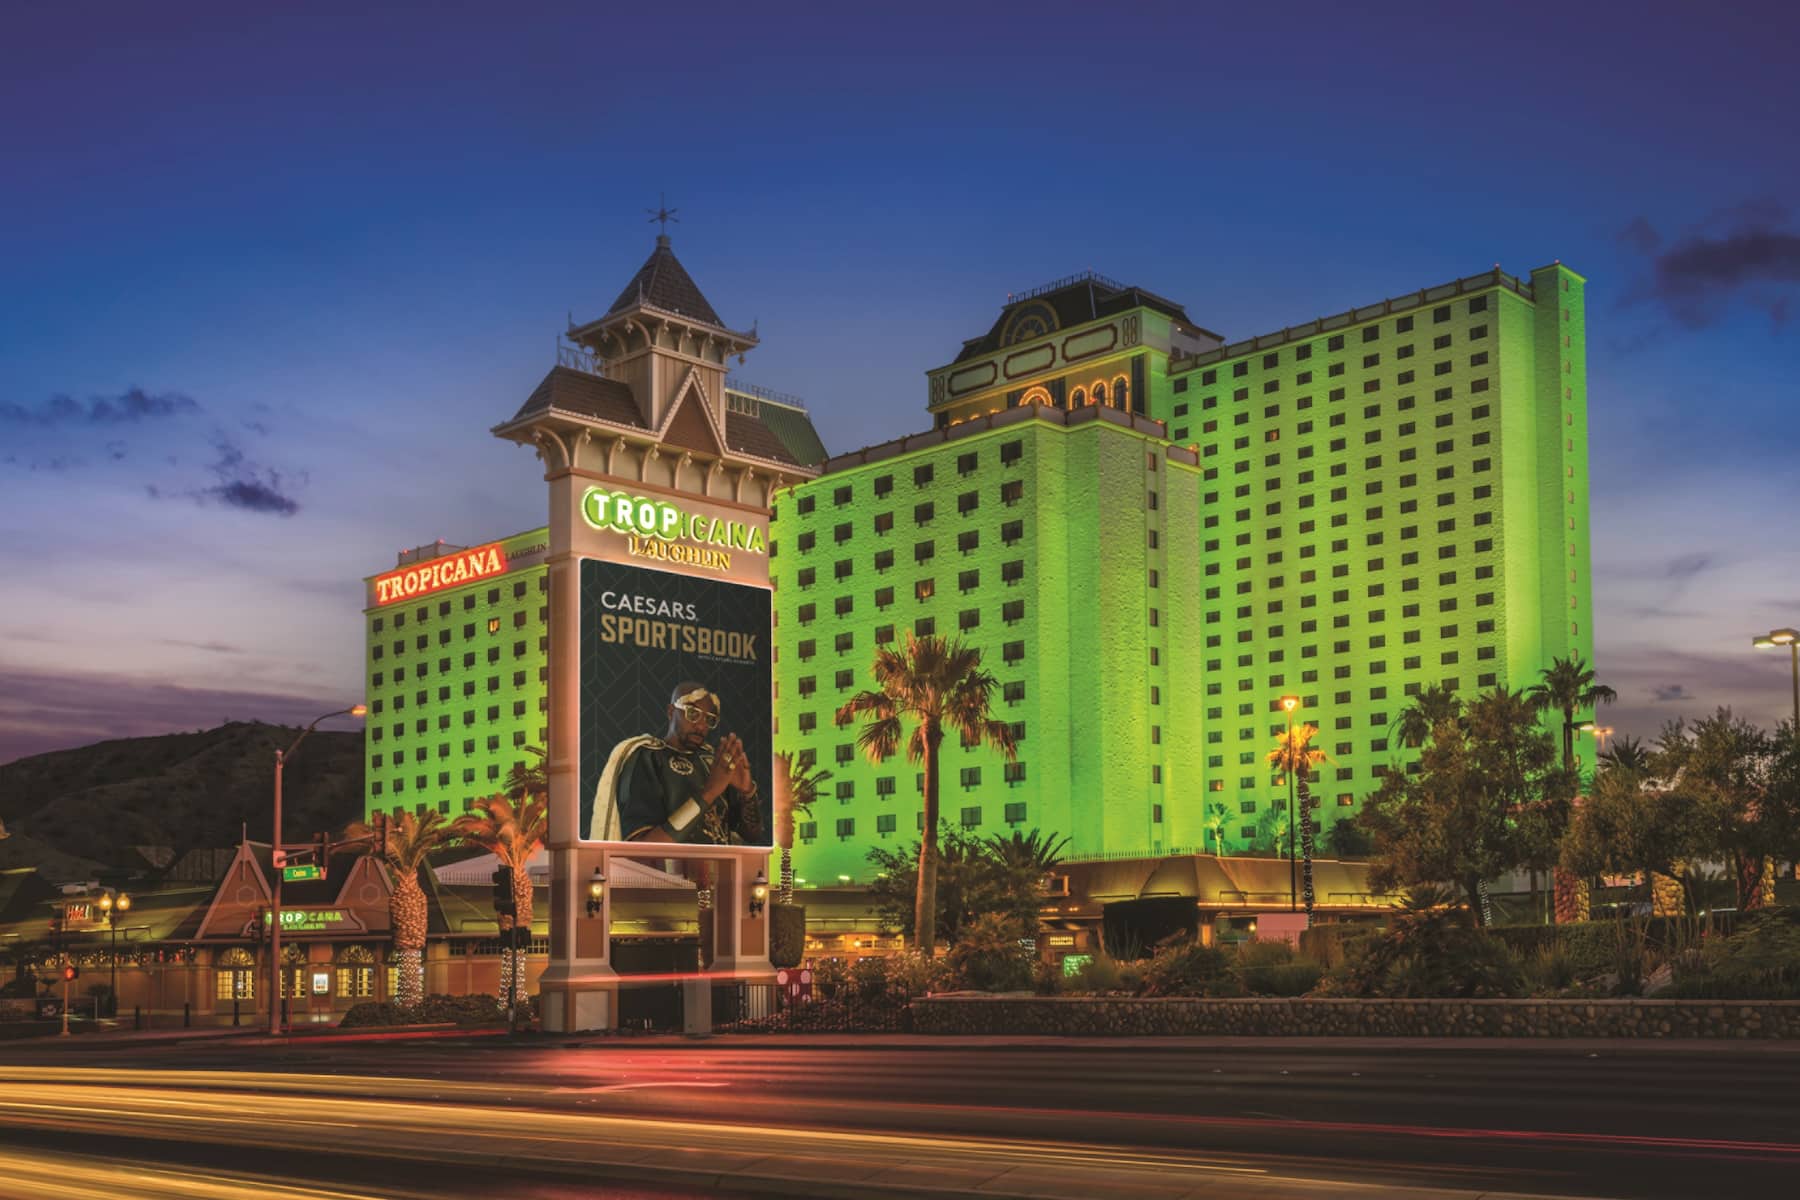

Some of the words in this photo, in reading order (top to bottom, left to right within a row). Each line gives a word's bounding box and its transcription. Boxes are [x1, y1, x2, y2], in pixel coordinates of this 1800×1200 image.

[592, 493, 766, 552] TROPICANA
[628, 535, 731, 570] LAUGHLIN
[377, 548, 501, 602] TROPICANA
[600, 591, 697, 621] CAESARS
[600, 613, 757, 660] SPORTSBOOK
[267, 911, 343, 922] TOPCANA
